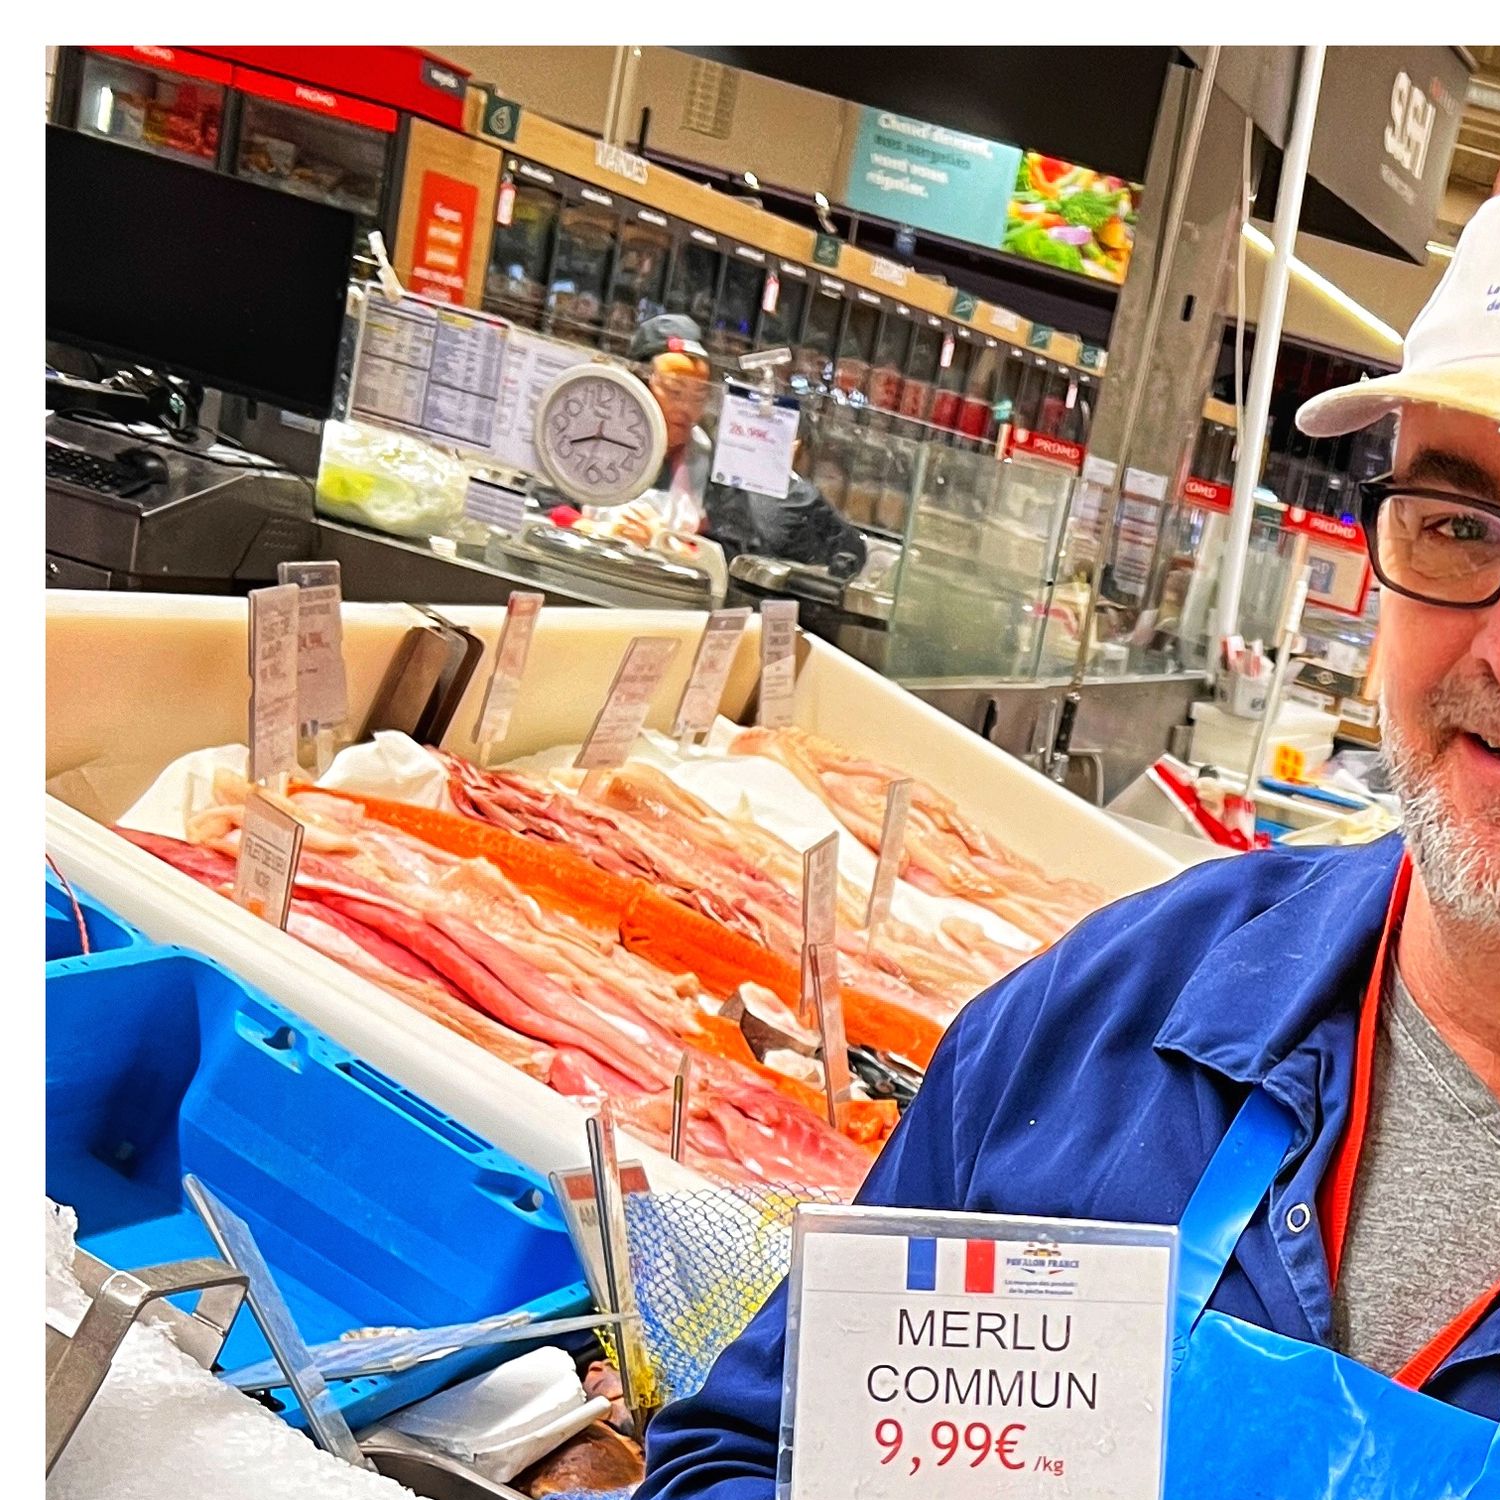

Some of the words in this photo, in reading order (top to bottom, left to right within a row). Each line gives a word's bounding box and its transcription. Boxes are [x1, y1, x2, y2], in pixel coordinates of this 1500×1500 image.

[1487, 284, 1500, 295] La
[1486, 299, 1500, 312] de
[1033, 438, 1080, 459] PROMO
[1309, 516, 1357, 539] PROMO
[898, 1308, 1071, 1352] MERLU
[867, 1364, 1097, 1410] COMMUN
[875, 1418, 1027, 1476] 9,99€
[1033, 1455, 1064, 1477] /kg
